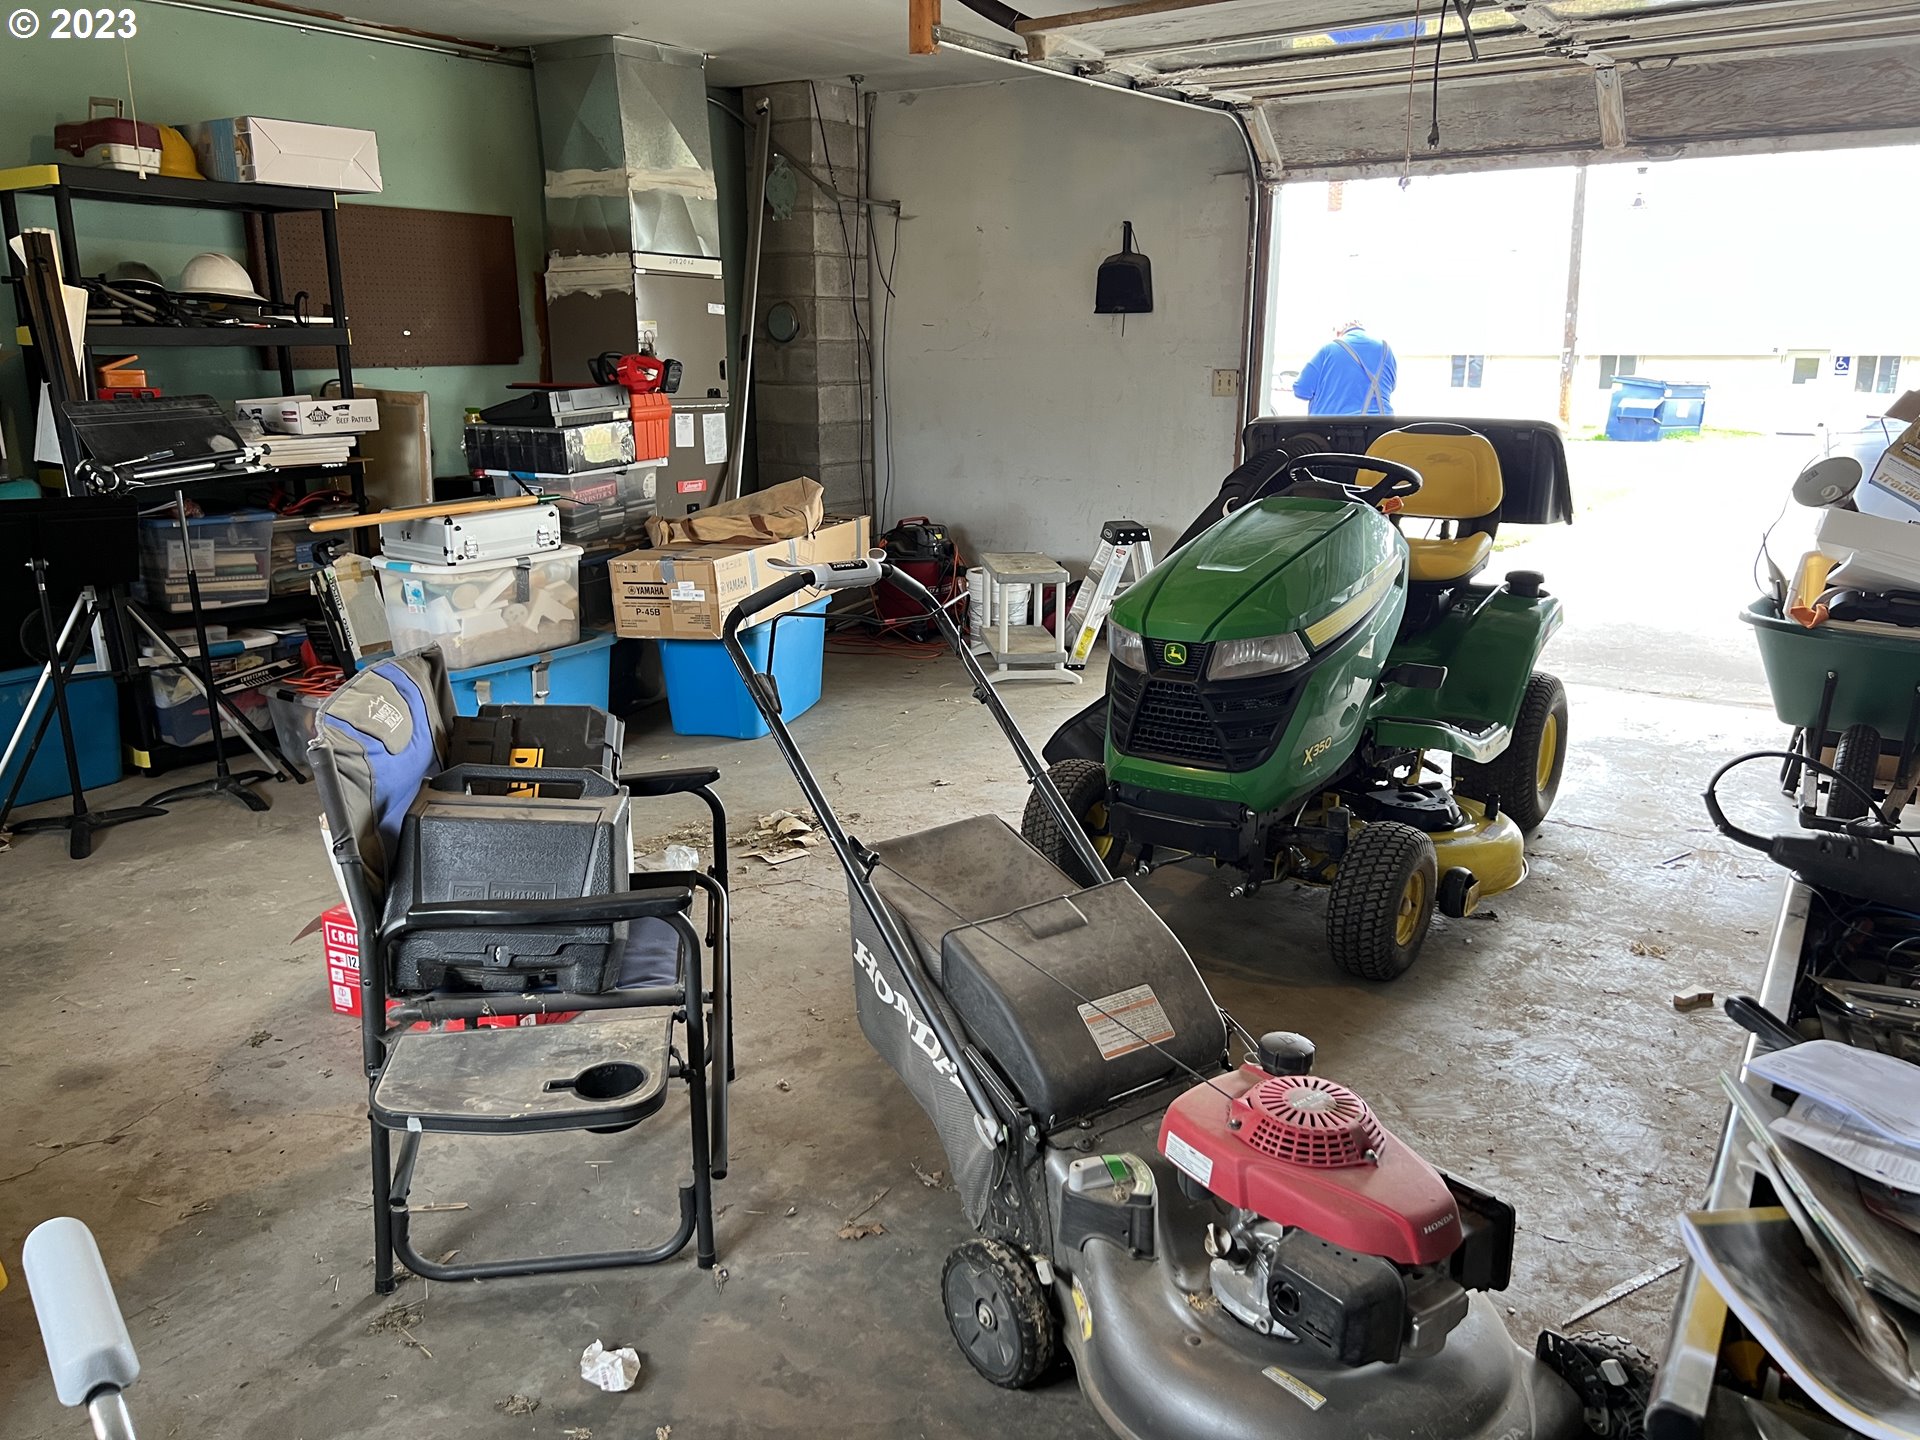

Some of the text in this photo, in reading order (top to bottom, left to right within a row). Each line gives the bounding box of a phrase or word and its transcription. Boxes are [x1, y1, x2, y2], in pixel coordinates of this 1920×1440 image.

[335, 416, 349, 424] BEEF
[636, 586, 664, 595] YAMAHA
[725, 576, 747, 593] YAMAHA
[636, 608, 661, 616] P-45B
[240, 670, 269, 683] CRAFTSMAN
[1302, 736, 1332, 766] X350
[853, 938, 967, 1094] HONDA
[1423, 1213, 1454, 1235] HONDA
